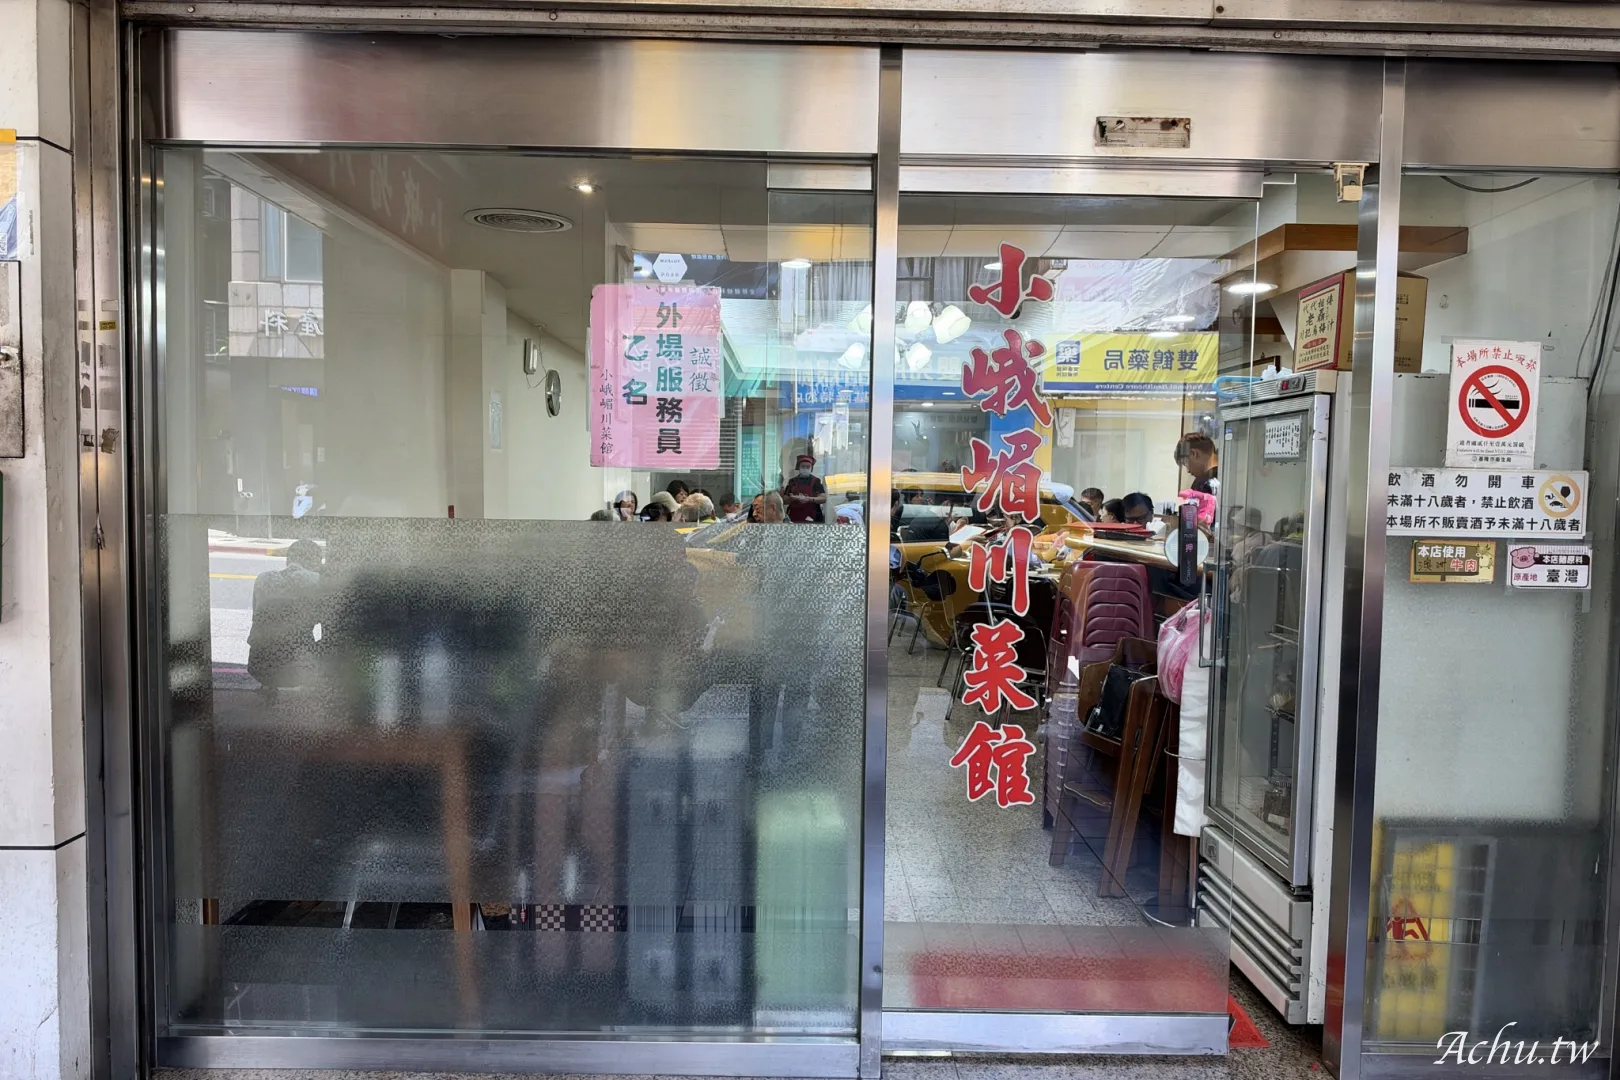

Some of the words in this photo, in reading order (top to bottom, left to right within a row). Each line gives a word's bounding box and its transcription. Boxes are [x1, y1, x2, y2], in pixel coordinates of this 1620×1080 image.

[622, 334, 648, 405] 乙名
[1456, 345, 1537, 372] 本場所禁止吸菸
[655, 301, 683, 455] 外場服務員
[689, 347, 713, 393] 誠徵
[600, 369, 614, 455] 小峨嵋川菜館
[1388, 472, 1535, 489] 飲酒勿開車
[951, 241, 1054, 808] 小峨嵋川菜館
[1386, 515, 1581, 531] 本場所不販賣酒予未滿十八歲者
[1417, 545, 1466, 558] 本店使用
[1450, 559, 1478, 572] 牛肉
[1546, 569, 1579, 583] 臺灣
[1513, 573, 1538, 582] 原產地
